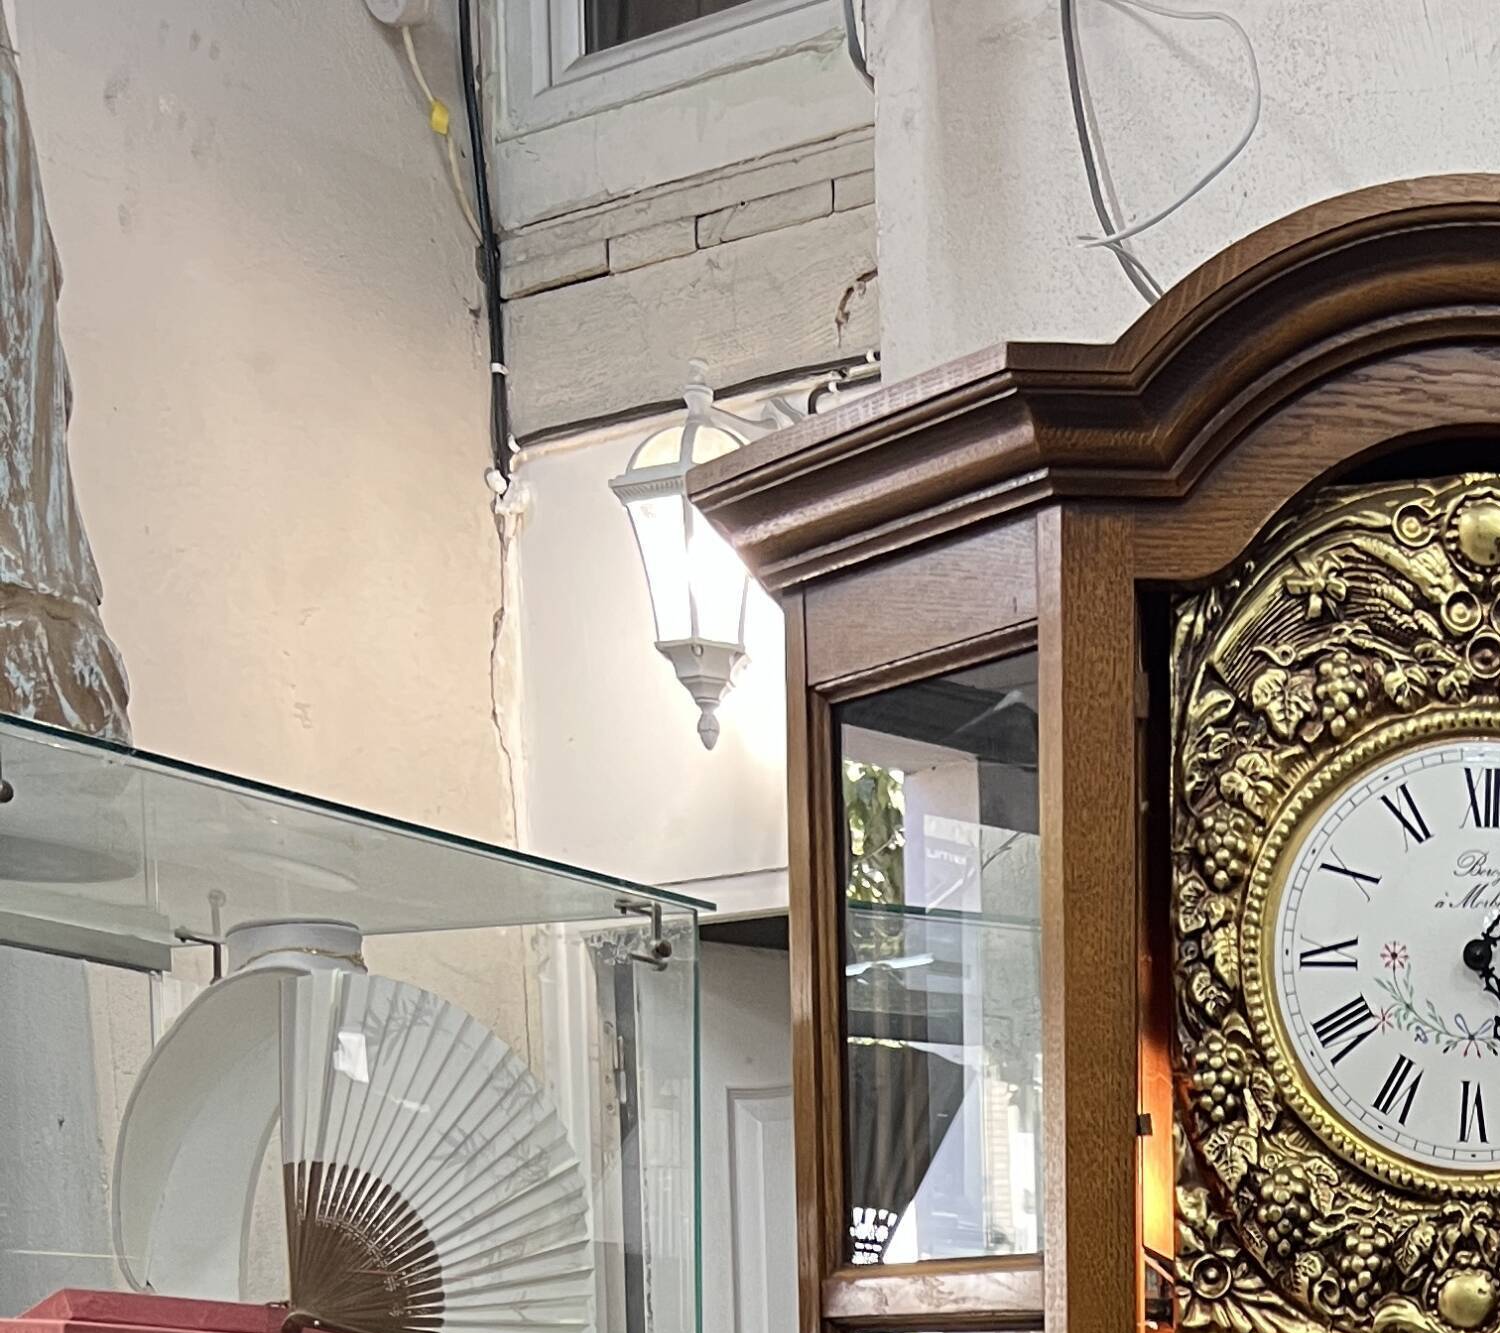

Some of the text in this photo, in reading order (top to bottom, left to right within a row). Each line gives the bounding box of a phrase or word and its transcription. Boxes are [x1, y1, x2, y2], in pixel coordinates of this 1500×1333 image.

[1380, 784, 1435, 852] XI
[1318, 847, 1382, 902] X
[1299, 935, 1360, 972] IX
[1312, 994, 1378, 1066] VIII
[1372, 1053, 1425, 1126] VII
[1459, 1080, 1488, 1144] VI
